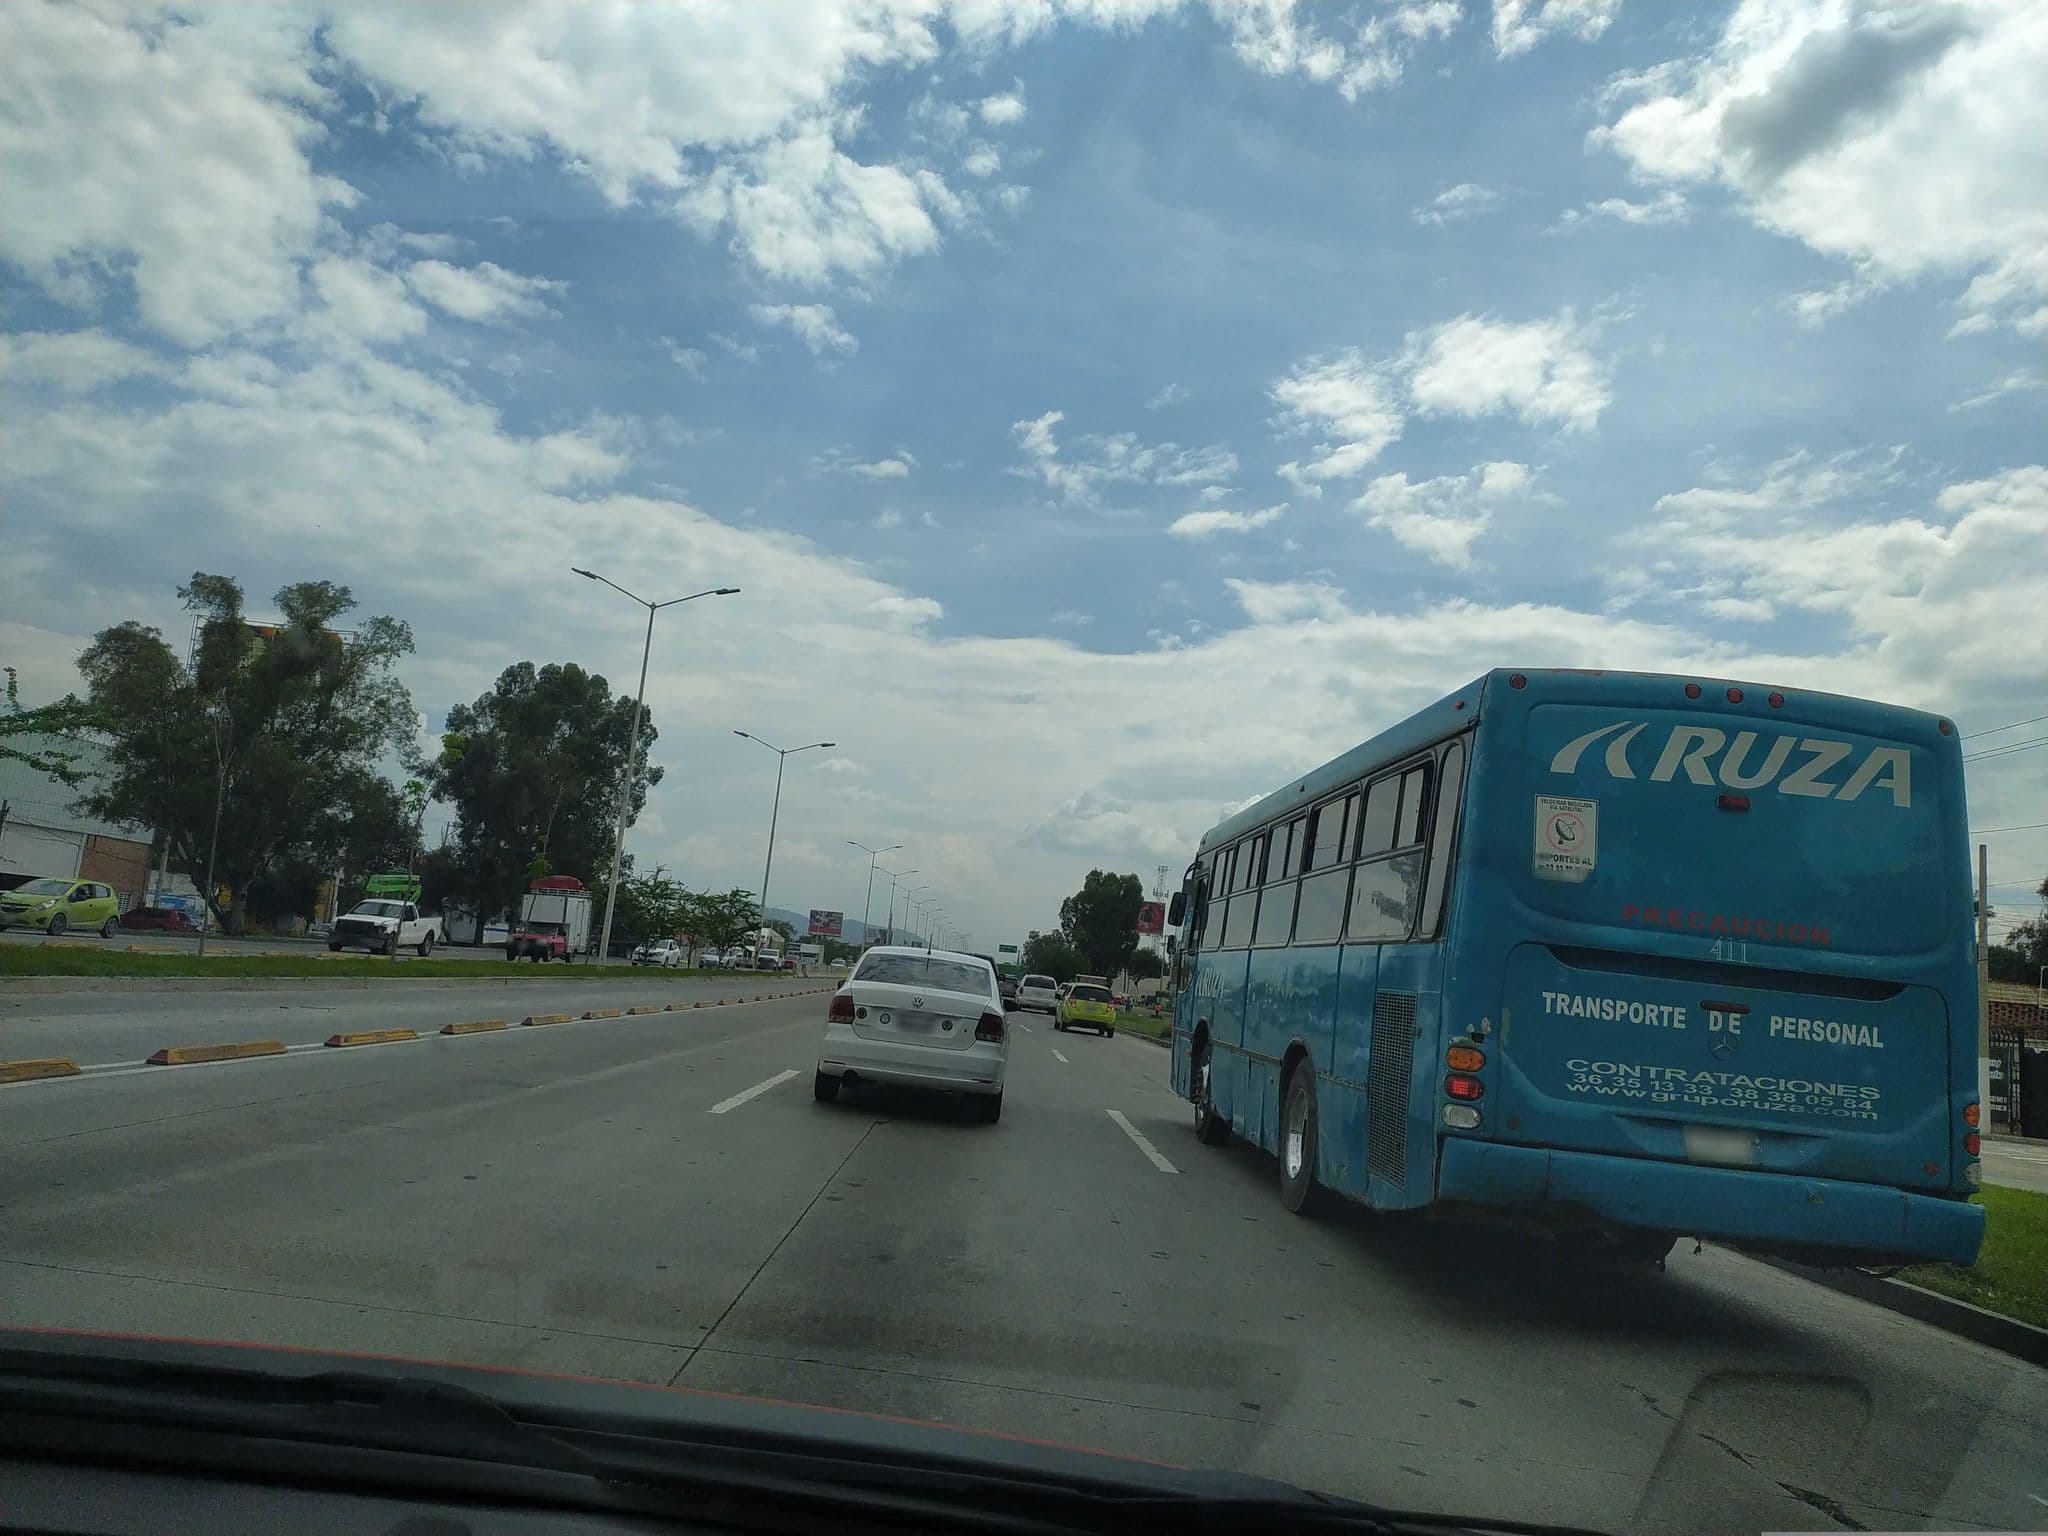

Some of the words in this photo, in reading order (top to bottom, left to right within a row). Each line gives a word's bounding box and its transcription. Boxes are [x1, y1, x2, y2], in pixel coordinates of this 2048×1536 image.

[1649, 725, 1911, 808] RUZA
[1623, 904, 1833, 946] PRECAUCION
[1542, 991, 1687, 1029] TRANSPORTE
[1708, 1010, 1742, 1035] DE
[1770, 1015, 1884, 1048] PERSONAL
[1566, 1059, 1881, 1100] CONTRATACIONES
[1573, 1073, 1603, 1085] 36
[1612, 1077, 1641, 1088] 35
[1650, 1081, 1675, 1092] 13
[1685, 1083, 1713, 1095] 33
[1729, 1087, 1759, 1100] 38
[1767, 1091, 1797, 1103] 38
[1805, 1095, 1834, 1107] 05
[1843, 1098, 1874, 1110] 84
